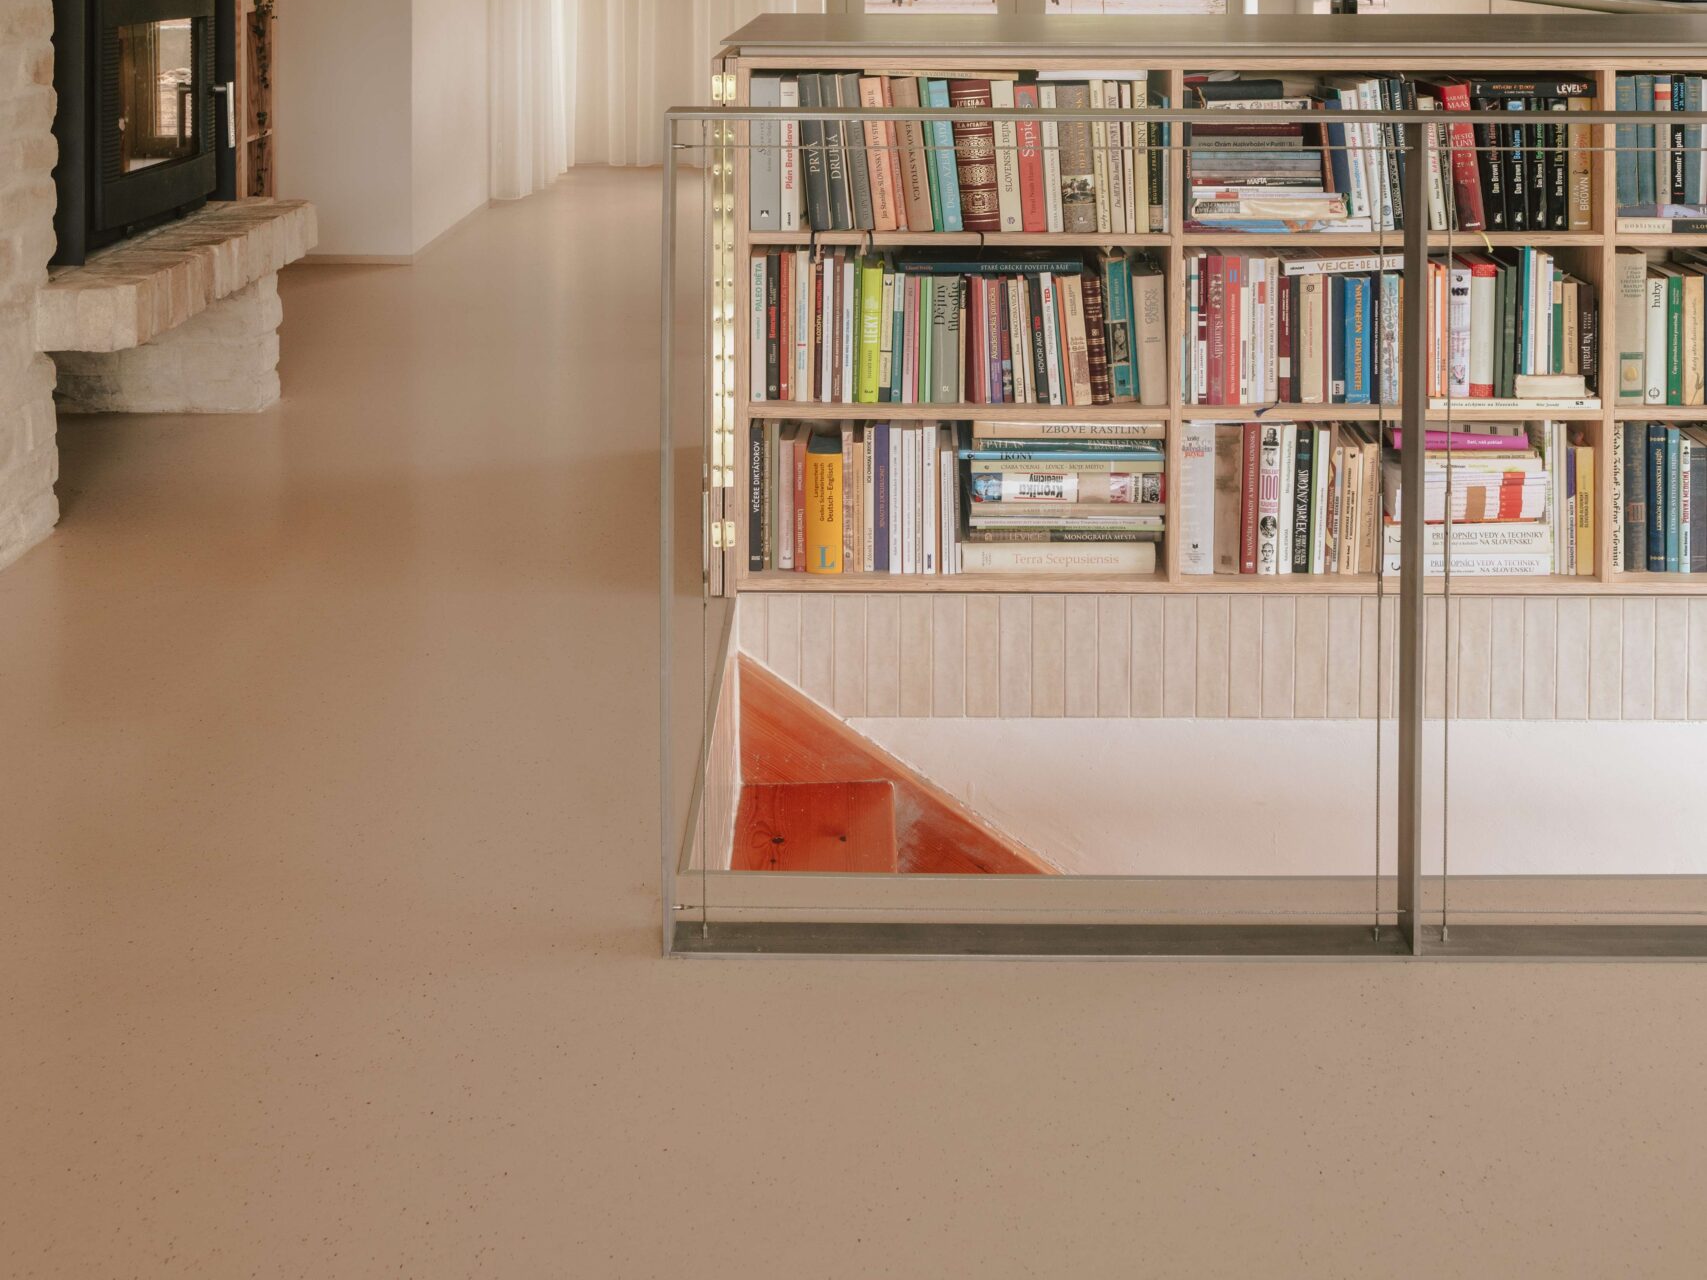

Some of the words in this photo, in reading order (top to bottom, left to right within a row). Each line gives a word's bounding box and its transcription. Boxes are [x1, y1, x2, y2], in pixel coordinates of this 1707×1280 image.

[1557, 84, 1582, 93] LEVEL
[1001, 121, 1010, 143] DEJIN
[785, 124, 793, 168] Bratslava
[806, 141, 820, 172] PRVÁ
[826, 134, 841, 179] DRUHÁ
[785, 170, 793, 189] Plán
[1002, 145, 1013, 192] SLOVENSK
[1491, 164, 1499, 181] Brown
[909, 165, 921, 201] STOLICA
[1247, 177, 1267, 185] MAFIA
[1514, 183, 1522, 194] Dan
[1555, 186, 1563, 196] Dan
[1579, 177, 1589, 210] BROWN
[754, 263, 762, 285] DIÉTA
[1317, 261, 1355, 271] VEJCE
[1360, 260, 1370, 269] DE
[934, 283, 947, 325] Dějiny
[1651, 281, 1662, 308] huby
[948, 282, 959, 332] filosofie
[1354, 284, 1362, 332] NAPOLEON
[864, 314, 878, 344] LIEKY
[1583, 333, 1593, 344] Na
[1037, 347, 1045, 373] HOVOR
[1354, 337, 1362, 390] BONAPARTE
[1582, 346, 1591, 369] prahu
[1090, 425, 1148, 434] RASTLINY
[752, 441, 760, 485] DIKTÁTOROV
[1000, 452, 1033, 460] IKONY
[752, 487, 760, 512] VEČERE
[1018, 483, 1064, 498] Kronika
[1261, 475, 1278, 500] 100
[1432, 531, 1478, 539] PRIOPNÍCI
[1013, 553, 1042, 564] Terra
